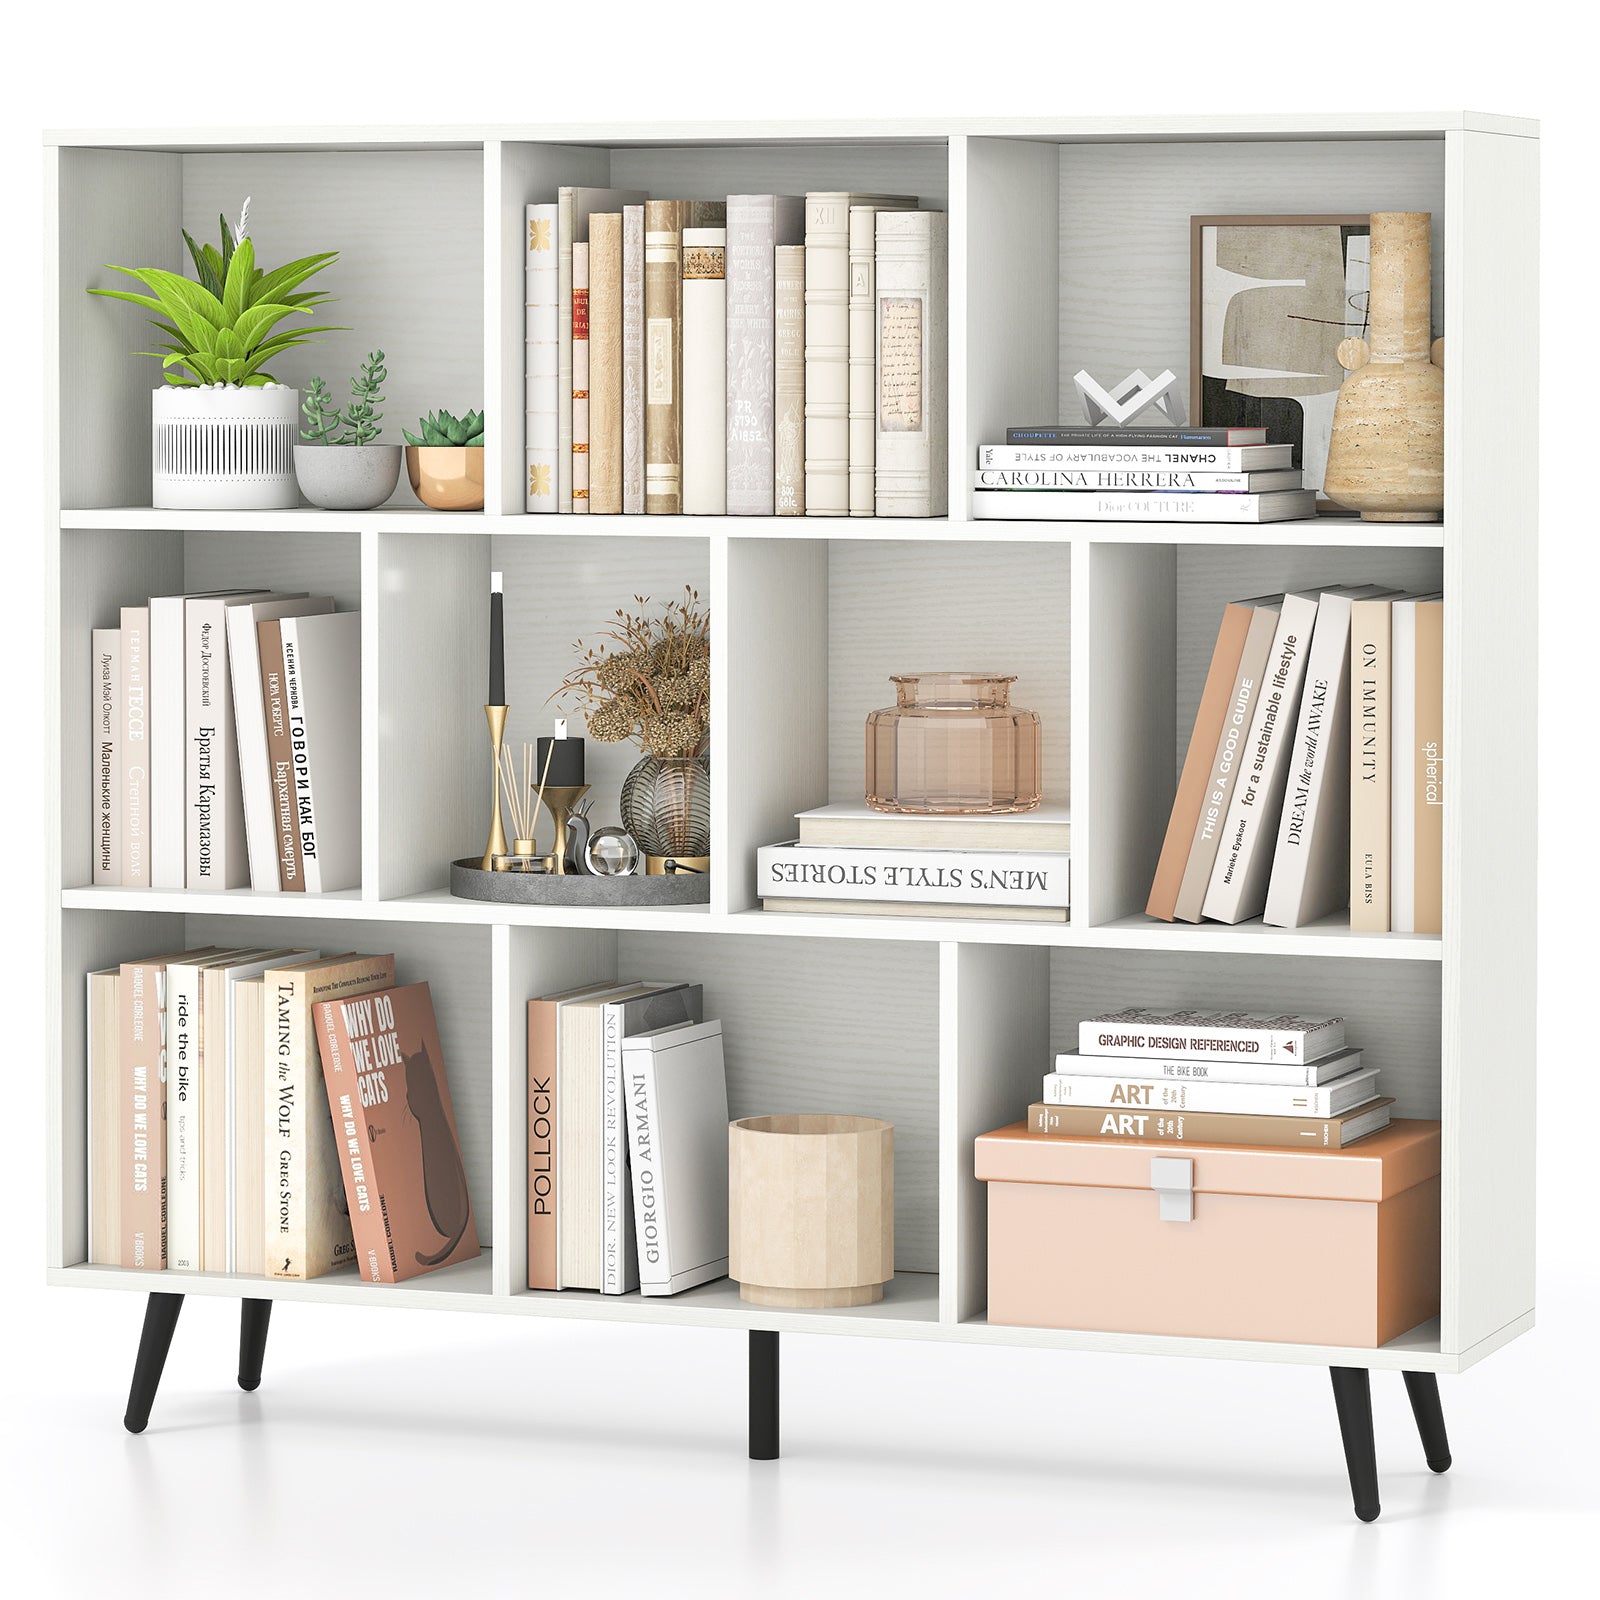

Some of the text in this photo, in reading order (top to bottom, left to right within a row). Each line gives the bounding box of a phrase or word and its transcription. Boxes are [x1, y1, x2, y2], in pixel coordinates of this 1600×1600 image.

[856, 272, 866, 287] A
[735, 400, 752, 414] PR
[981, 471, 1195, 488] CAROLINA HERRERA
[985, 448, 994, 465] Yale
[1015, 453, 1046, 462] STYLE
[1050, 453, 1063, 461] OF
[1067, 453, 1138, 462] VOCABULARY
[1141, 454, 1161, 462] THE
[1165, 453, 1216, 463] CHANEL
[102, 653, 112, 734] Луиза Мэй Олкотт
[268, 672, 279, 696] НОРА
[286, 642, 299, 710] КСЕНИЯ ЧЕРНОВА
[128, 686, 144, 741] ГЕССЕ
[1242, 635, 1297, 806] for a sustainable lifestyle
[1363, 643, 1377, 784] ON IMMUNITY
[291, 717, 316, 859] ГОВОРИ КАК БОГ
[1201, 678, 1253, 841] THIS IS A GOOD GUIDE
[1287, 679, 1328, 846] DREAM the world AWAKE
[1422, 742, 1443, 805] spherical
[101, 742, 113, 871] Маленькие женщины
[194, 727, 215, 877] Братья Карамазовы
[273, 761, 296, 880] Бархатная смерть
[771, 862, 1048, 891] MEN'S STYLE STORIES
[1223, 819, 1247, 884] Marieke Eyskoot
[340, 994, 395, 1039] WHY DO
[1098, 1033, 1146, 1049] GRAPHIC
[1148, 1036, 1187, 1050] DESIGN
[1190, 1038, 1260, 1053] REFERENCED
[178, 995, 189, 1102] ride the bike
[350, 1032, 402, 1073] WE LOVE
[1163, 1065, 1208, 1077] THE BIKE BOOK
[278, 982, 294, 1233] TAMING the WOLF GREG STONE
[357, 1071, 389, 1108] CATS
[1110, 1085, 1154, 1105] ART
[134, 1066, 147, 1192] WHY DO WE LOVE CATS
[340, 1094, 370, 1212] WHY DO WE LOVE CATS
[533, 1076, 551, 1215] POLLOCK
[606, 1012, 617, 1286] DIOR. NEW LOOK REVOLUTION
[1100, 1113, 1149, 1136] ART
[633, 1073, 659, 1264] GIORGIO ARMANI
